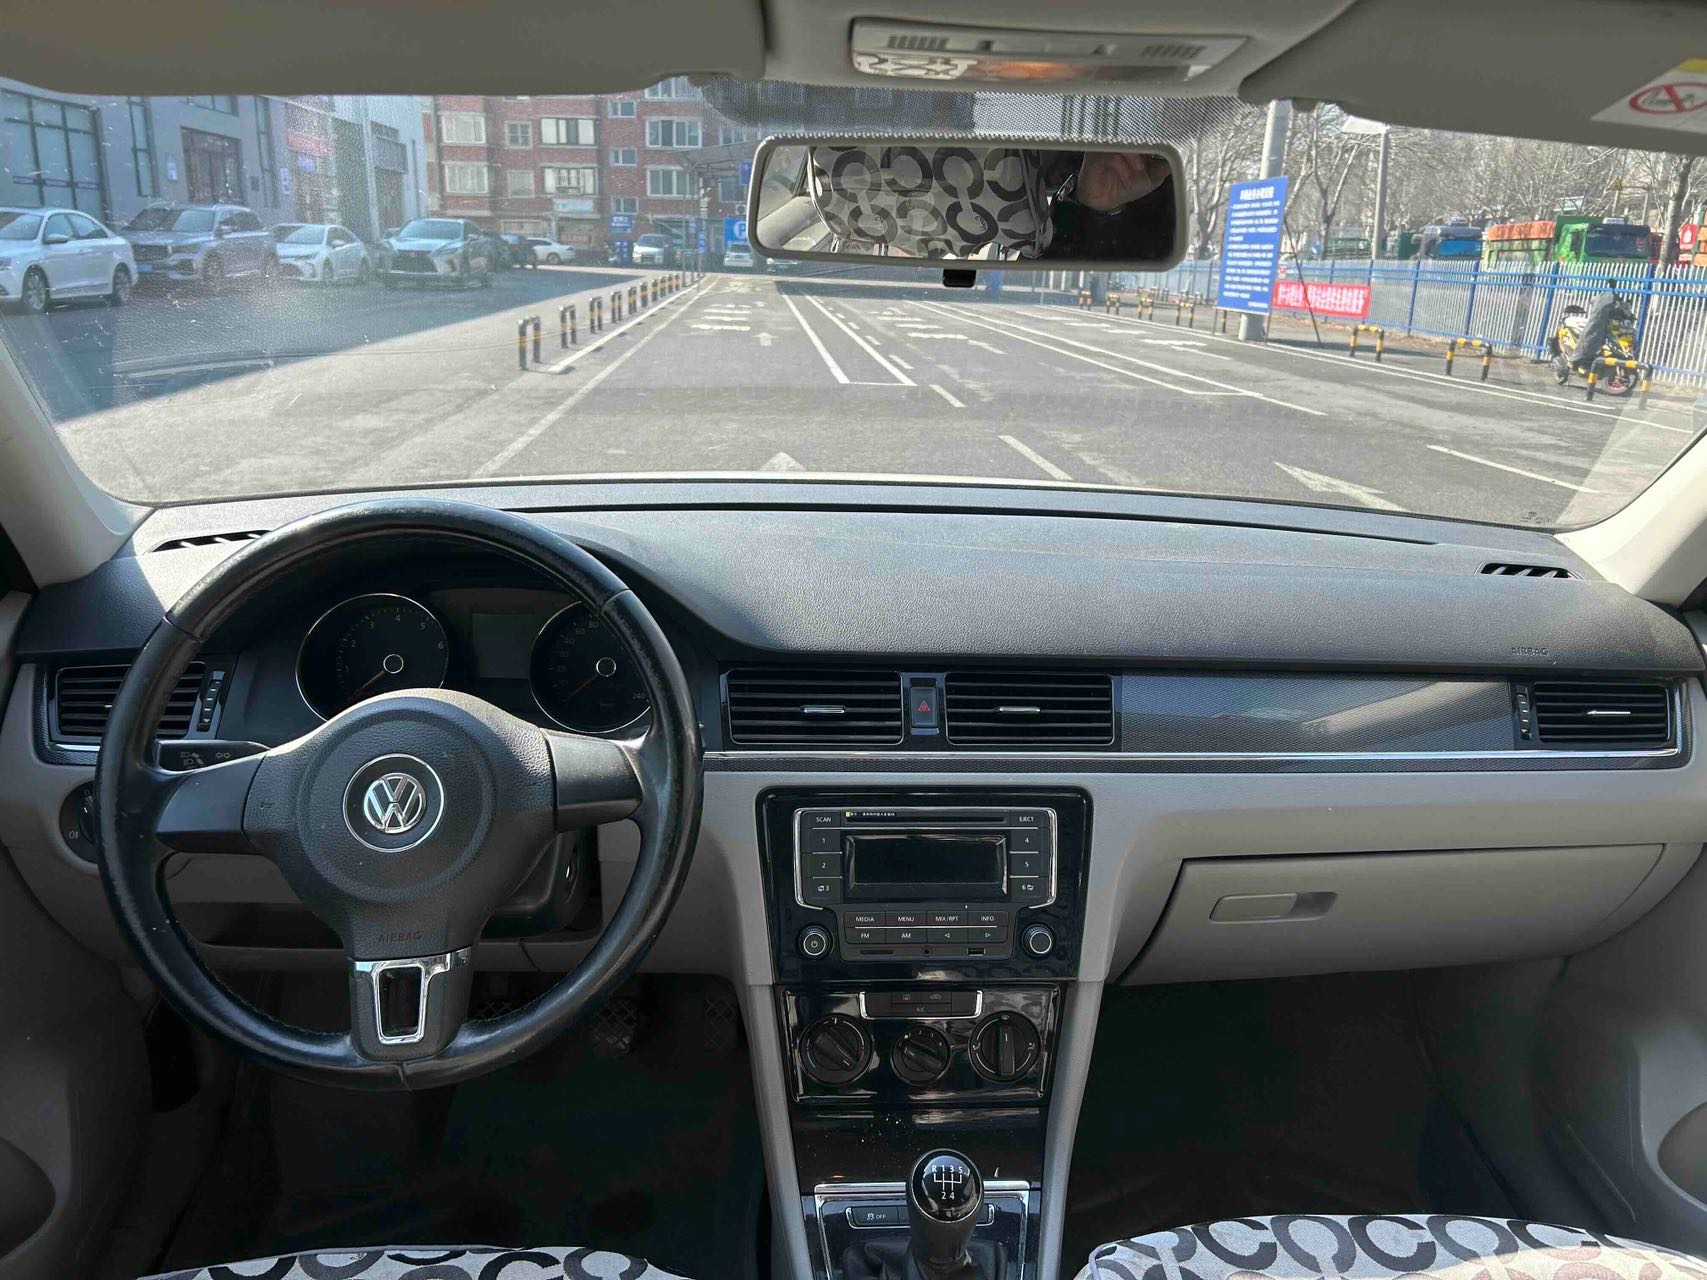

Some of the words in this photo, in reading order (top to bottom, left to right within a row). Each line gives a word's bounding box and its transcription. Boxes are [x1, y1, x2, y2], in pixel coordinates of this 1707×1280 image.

[394, 614, 401, 622] 4
[350, 640, 357, 648] 2
[438, 641, 444, 649] 6
[1511, 647, 1549, 657] AIRBAG
[821, 861, 827, 869] 2
[825, 884, 830, 892] 3
[378, 930, 421, 944] AIRBAG
[932, 1165, 939, 1173] R
[941, 1164, 946, 1173] 1
[949, 1165, 955, 1173] 3
[957, 1166, 964, 1174] 5
[941, 1191, 947, 1200] 2
[949, 1191, 956, 1200] 4
